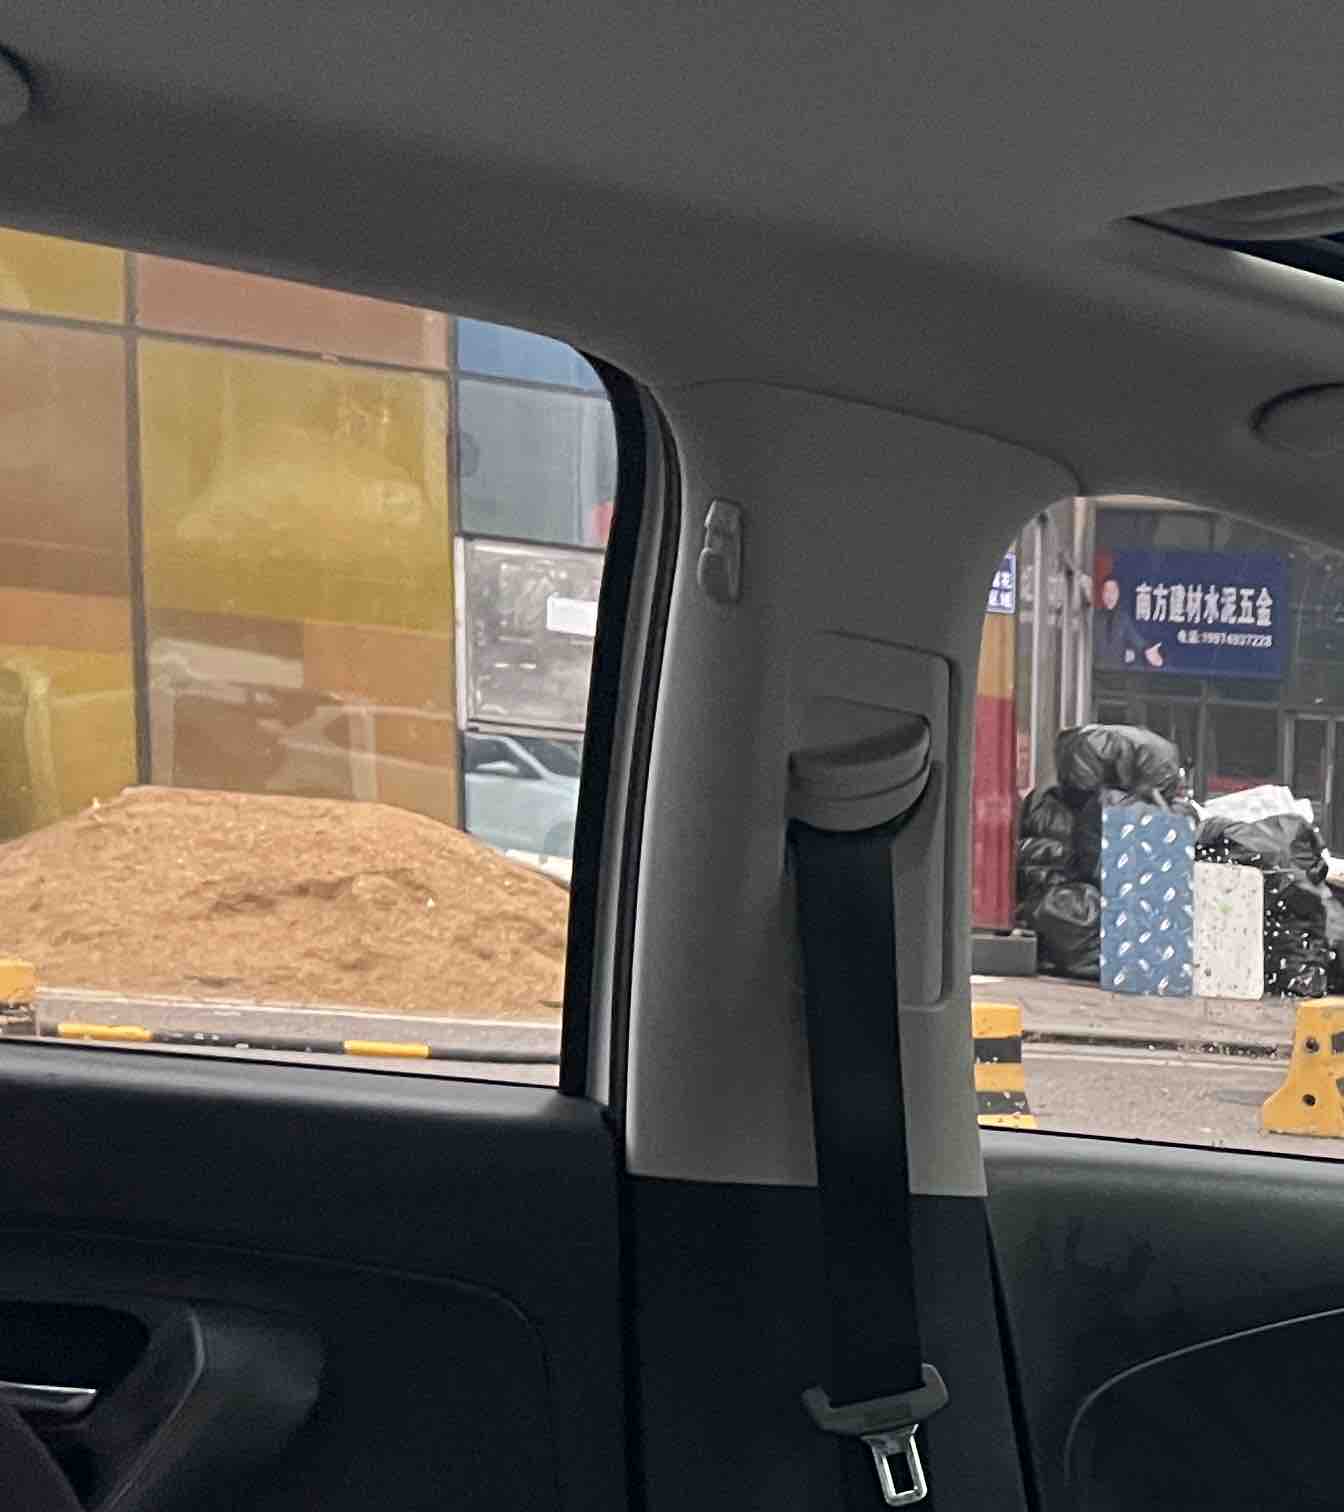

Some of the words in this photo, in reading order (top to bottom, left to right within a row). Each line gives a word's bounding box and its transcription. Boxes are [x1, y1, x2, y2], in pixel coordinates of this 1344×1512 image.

[1135, 581, 1273, 627] 南方建材水泥五金
